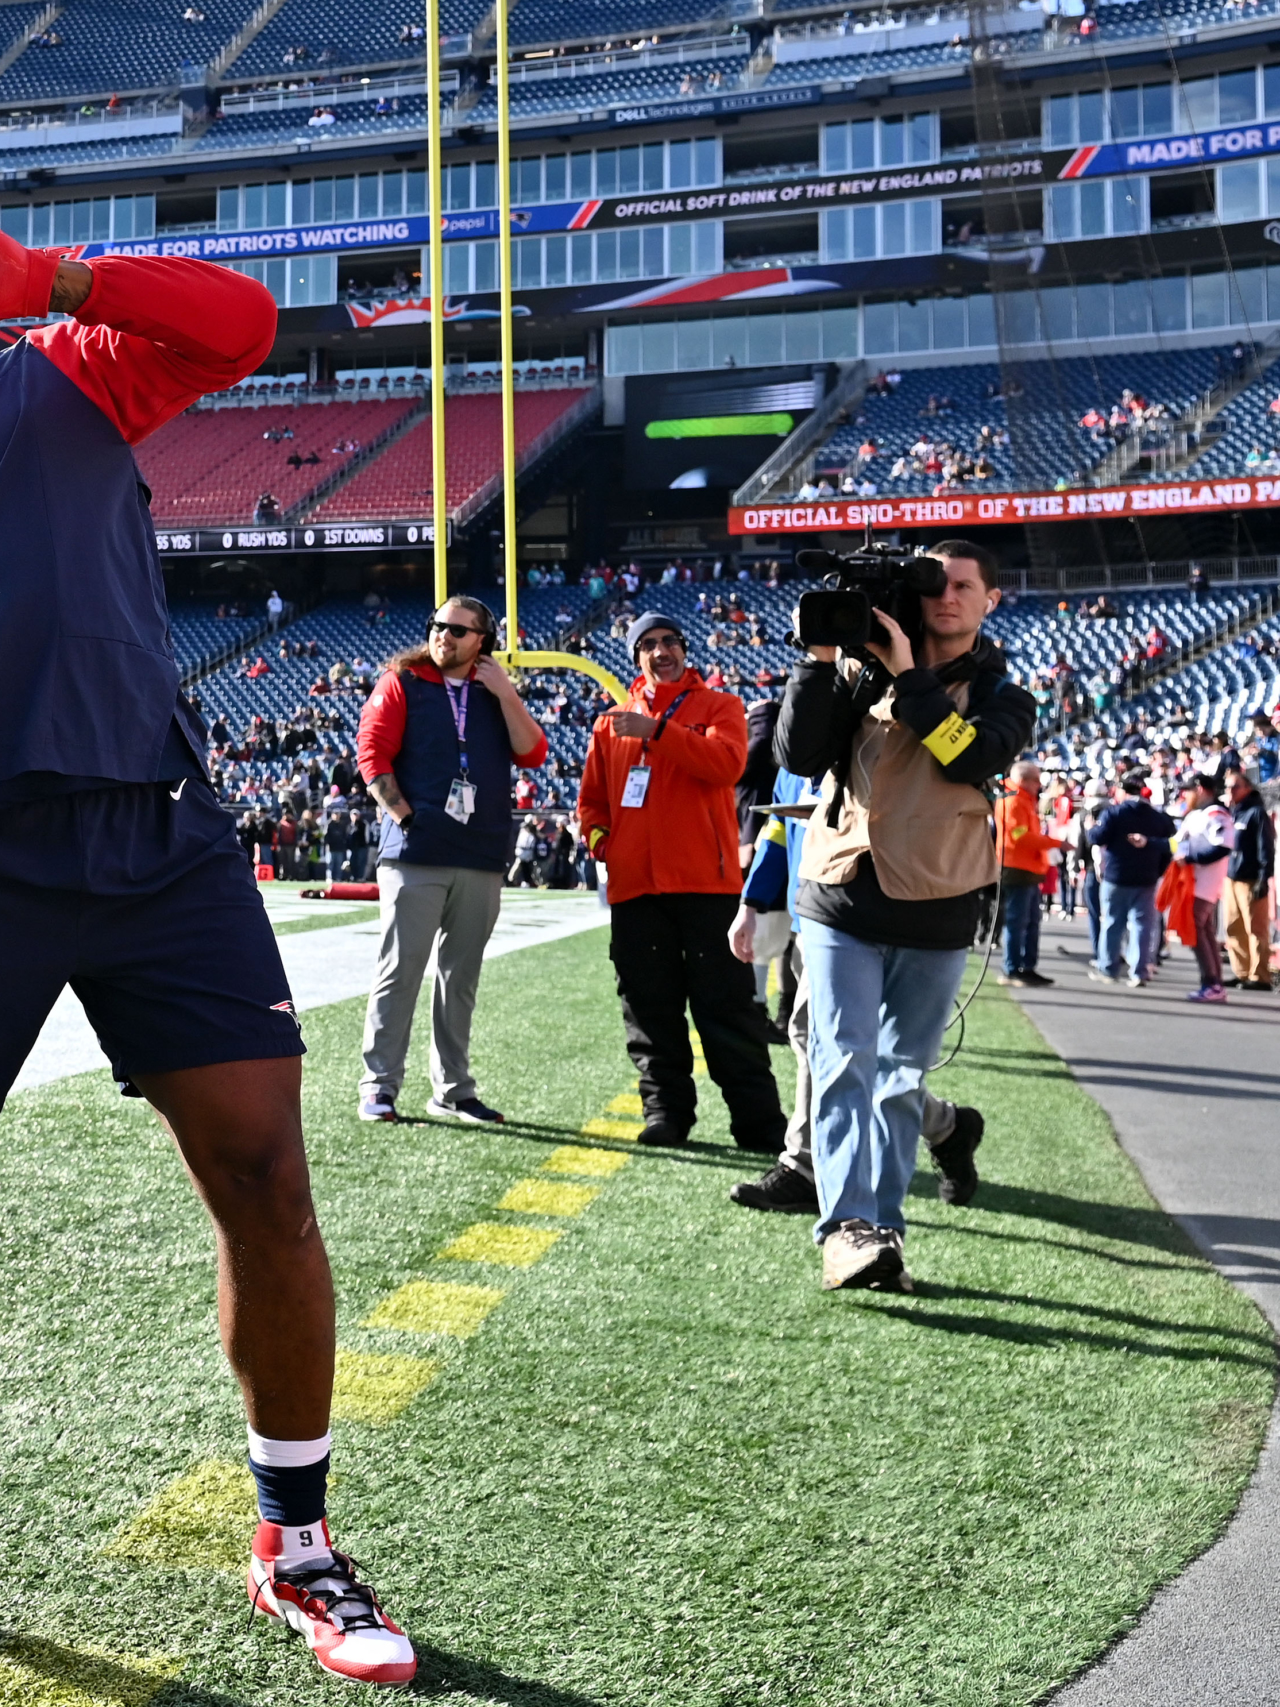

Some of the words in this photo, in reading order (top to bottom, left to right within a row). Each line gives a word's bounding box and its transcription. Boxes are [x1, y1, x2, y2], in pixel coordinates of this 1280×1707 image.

[615, 107, 648, 122] DELL
[1128, 141, 1204, 165] MADE
[1210, 133, 1263, 156] FOR
[615, 199, 684, 218] OFFICIAL
[687, 194, 725, 211] SOFT
[729, 188, 778, 207] DRINK
[781, 186, 803, 201] OF
[807, 183, 836, 199] THE
[839, 177, 876, 195] NEW
[879, 168, 957, 192] ENGLAND
[960, 159, 1043, 183] PATRIOTS
[450, 214, 485, 233] pepsi
[104, 243, 158, 256] MADE
[162, 241, 200, 257] FOR
[205, 233, 298, 254] PATRIOTS
[301, 222, 409, 248] WATCHING
[744, 506, 843, 529] OFFICIAL
[978, 497, 1009, 519] OF
[1014, 495, 1064, 516] THE
[1068, 492, 1126, 514] NEW
[1130, 483, 1251, 511] ENGLAND
[170, 534, 192, 549] YDS
[222, 532, 233, 549] 0
[238, 531, 265, 548] RUSH
[266, 530, 288, 547] YDS
[304, 530, 315, 546] 0
[324, 529, 343, 545] 1ST
[344, 528, 384, 544] DOWNS
[407, 526, 418, 542] 0
[299, 1530, 313, 1547] 9
